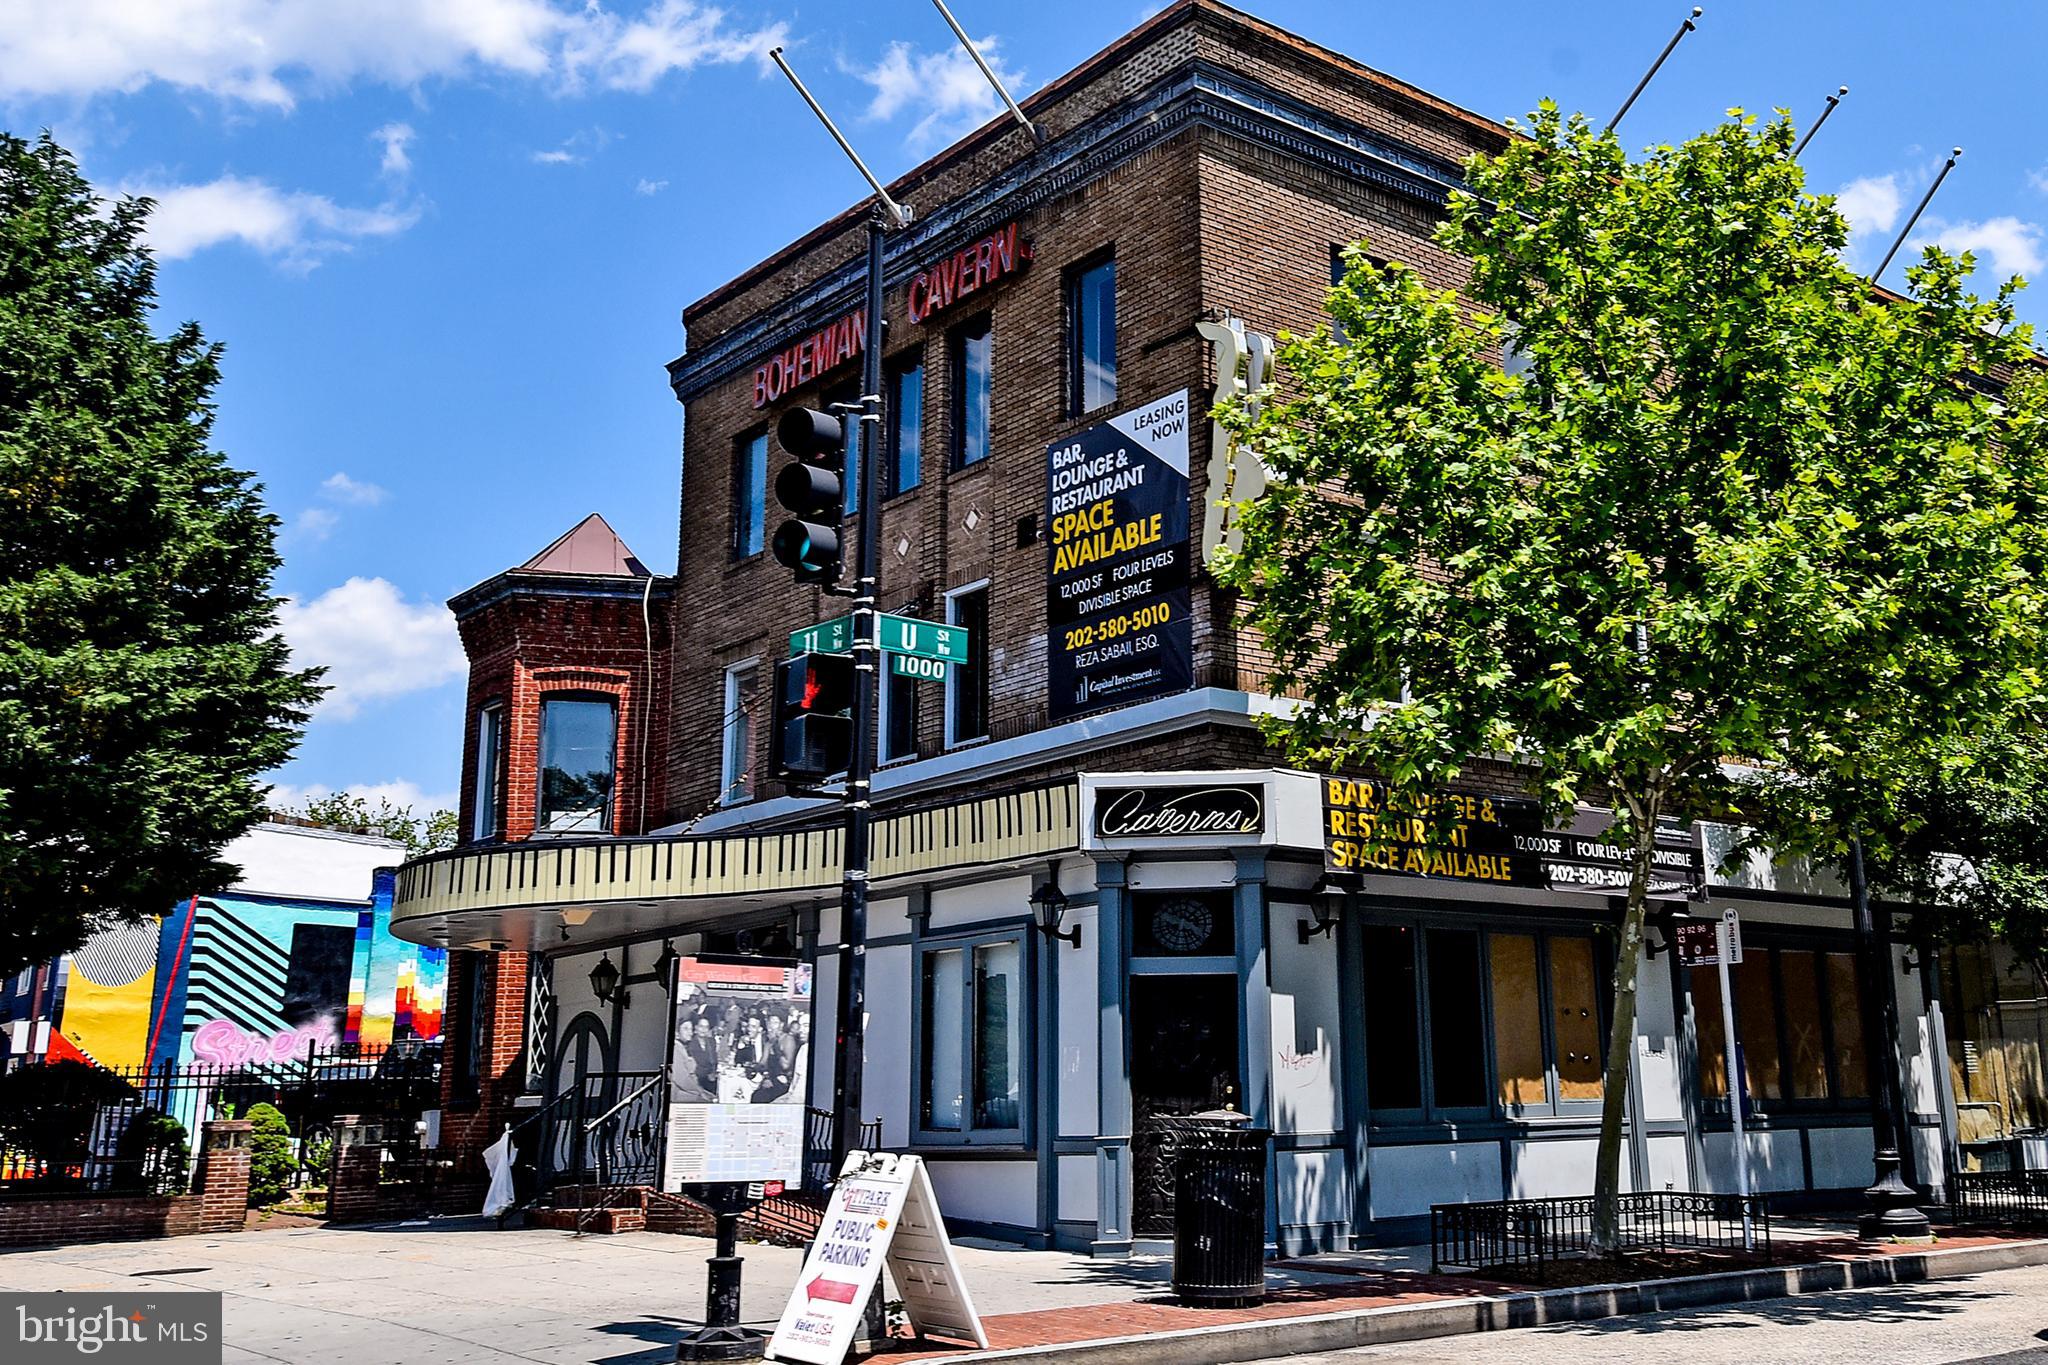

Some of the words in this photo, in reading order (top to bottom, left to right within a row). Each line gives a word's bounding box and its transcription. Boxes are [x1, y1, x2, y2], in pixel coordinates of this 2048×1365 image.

[754, 307, 868, 410] BOHEMIAN
[1134, 399, 1185, 431] LEASING
[1152, 417, 1185, 442] NOW
[1052, 443, 1086, 470] BAR,
[1052, 453, 1114, 492] LOUNGE
[1115, 448, 1129, 468] &
[1051, 464, 1145, 515] RESTAURANT
[1052, 499, 1114, 545] SPACE
[1052, 513, 1162, 575] AVAILABLE
[1060, 578, 1091, 599] 12,000
[1092, 573, 1103, 589] SF
[1113, 561, 1140, 581] FOUR
[1141, 550, 1174, 572] LEVELS
[1079, 589, 1121, 615] DIVISIBLE
[1122, 579, 1152, 600] SPACE
[804, 630, 819, 653] 11
[832, 624, 844, 637] St
[901, 622, 918, 650] U
[936, 629, 950, 642] St
[1065, 602, 1170, 651] 202-580-5010
[898, 655, 945, 679] 1000
[1075, 651, 1100, 669] REZA
[1135, 634, 1160, 652] ESQ.
[1102, 789, 1250, 834] Caverns
[1328, 779, 1381, 813] BAR,
[1481, 798, 1498, 823] &
[1513, 834, 1549, 852] 12,000
[1549, 838, 1562, 854] SF
[1576, 841, 1605, 858] FOUR
[1403, 847, 1512, 881] AVAILABLE
[1696, 924, 1707, 933] 96
[1728, 922, 1737, 962] metrobus
[831, 1219, 875, 1243] PUBLIC
[817, 1242, 871, 1268] PARKING
